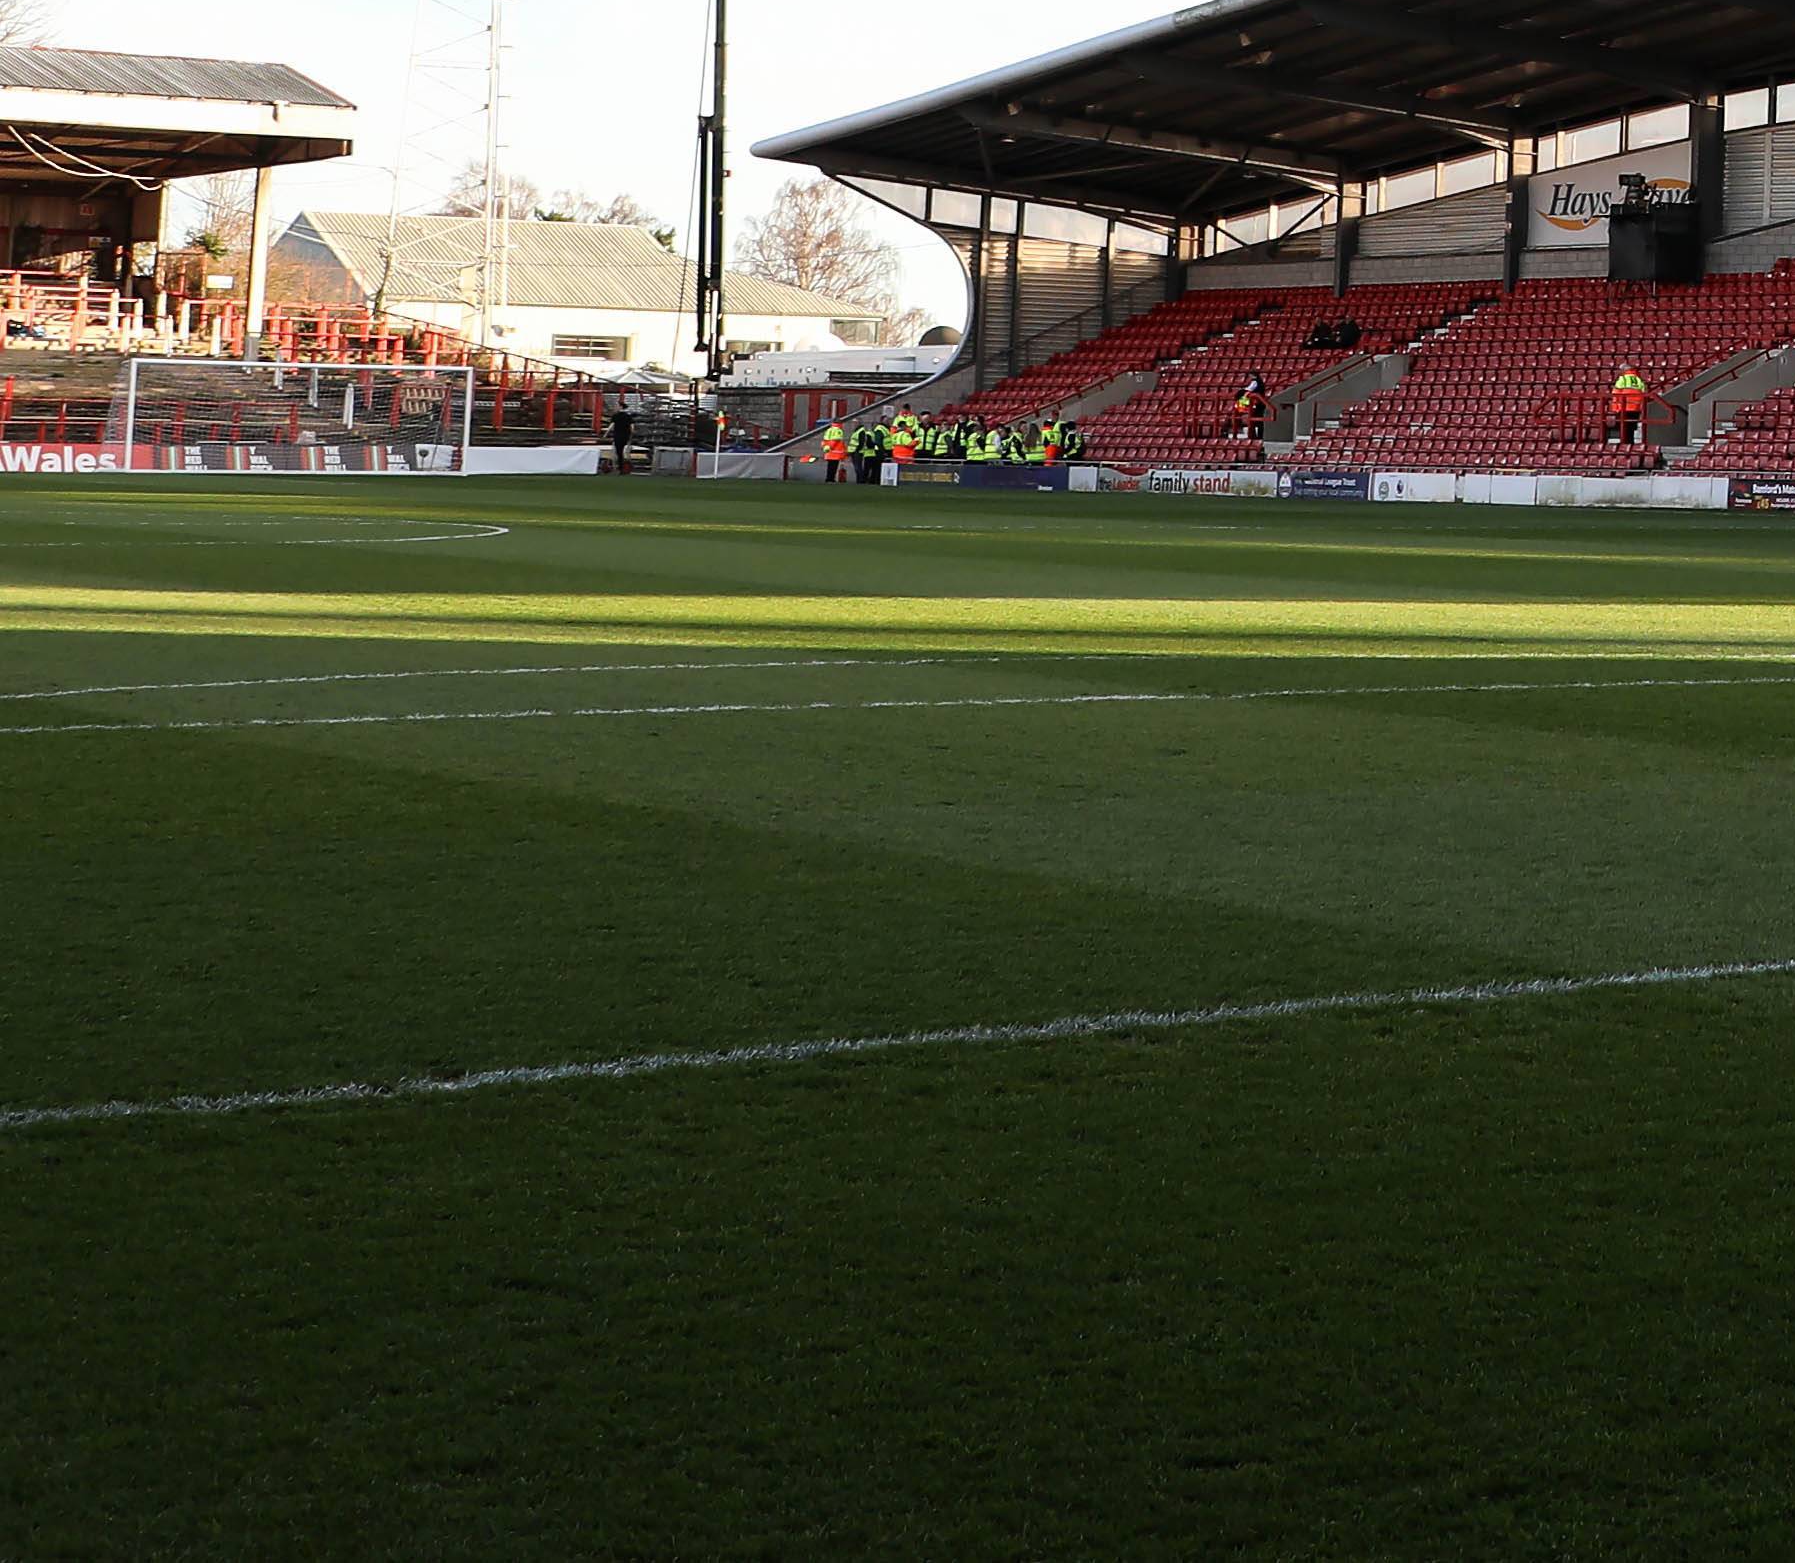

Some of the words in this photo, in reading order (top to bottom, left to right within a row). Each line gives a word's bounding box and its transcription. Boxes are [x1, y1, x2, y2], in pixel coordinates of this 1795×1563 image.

[1549, 183, 1611, 222] Hays
[1150, 472, 1190, 493] family
[1193, 472, 1231, 493] stand
